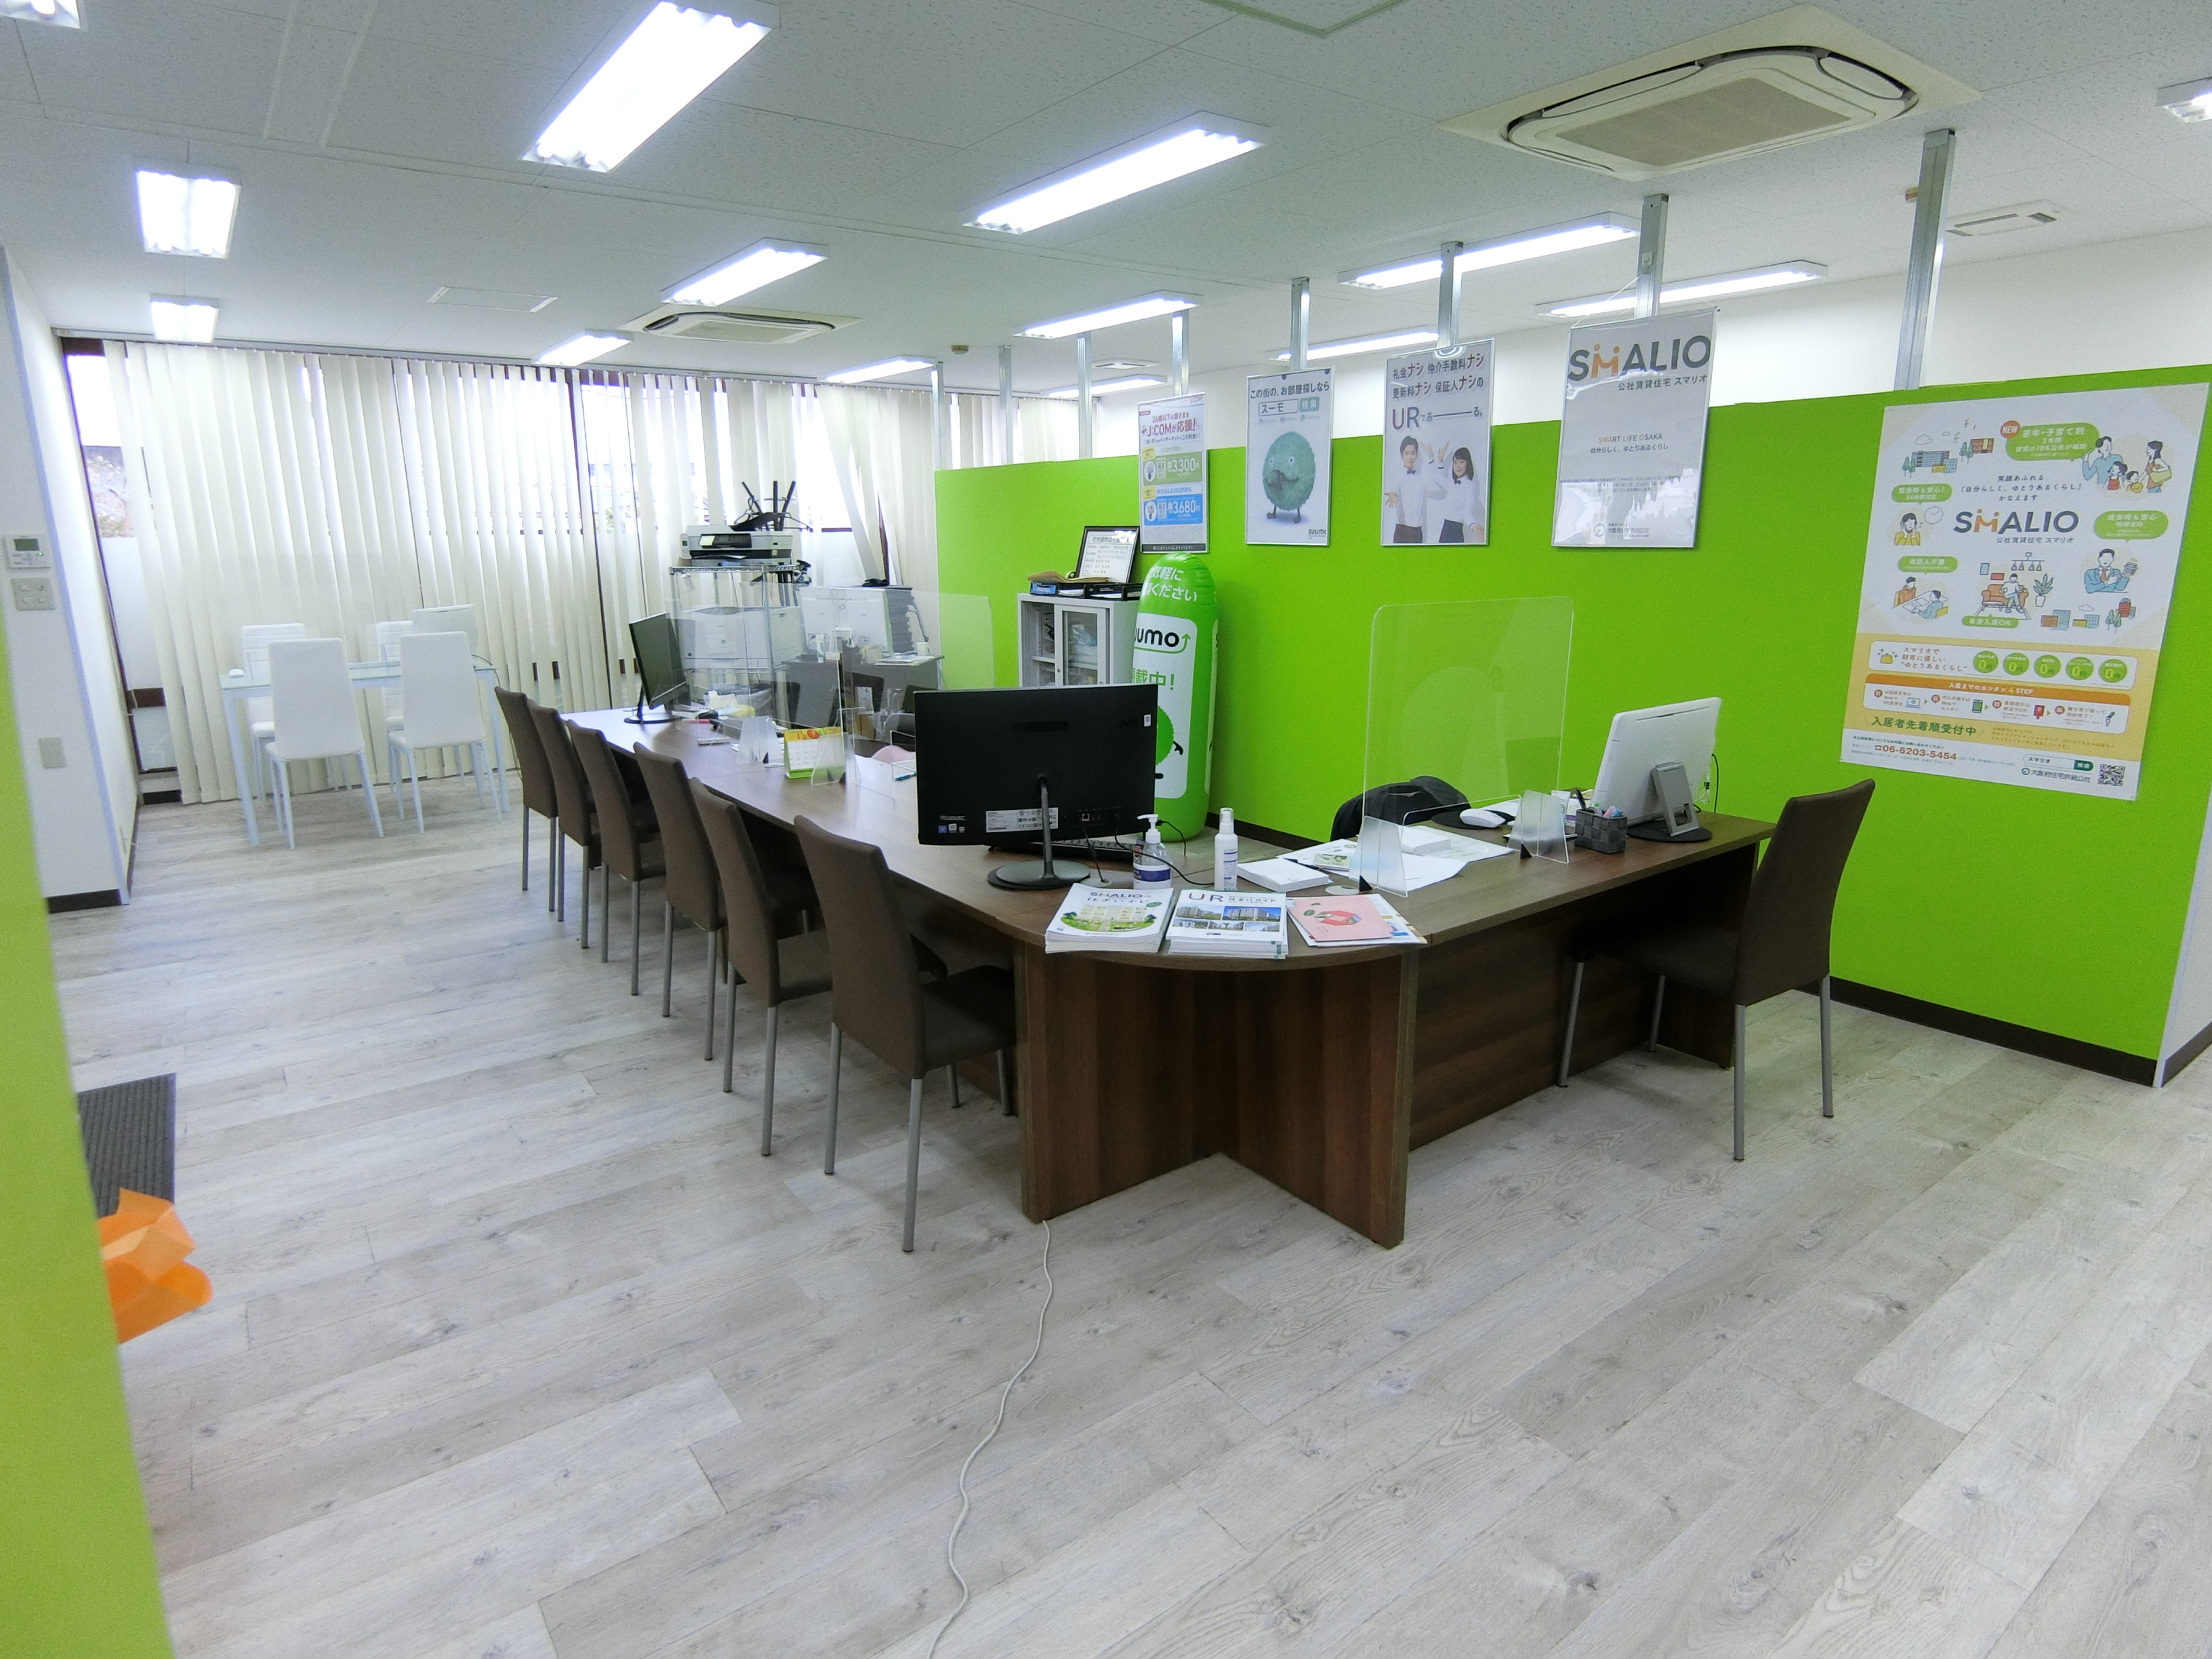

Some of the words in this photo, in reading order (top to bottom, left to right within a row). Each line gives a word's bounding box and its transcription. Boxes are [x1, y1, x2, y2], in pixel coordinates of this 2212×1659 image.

[1393, 363, 1424, 380] 礼金ナシ
[1427, 353, 1485, 375] 仲介手数料ナシ
[1567, 335, 1711, 382] SMALIO
[1250, 382, 1330, 398] この街の、お部屋探しなら
[1393, 381, 1431, 399] 更新料ナシ
[1435, 375, 1483, 393] 保証人ナシの
[1618, 378, 1671, 392] 公社賃貸住宅
[1674, 374, 1707, 386] スマリオ
[1261, 403, 1284, 413] スーモ
[2002, 426, 2018, 434] NEW
[1598, 436, 1620, 444] SMART
[1639, 433, 1662, 441] OSAKA
[1953, 509, 2079, 535] SMALIO
[2015, 687, 2034, 695] STEP
[1871, 716, 1977, 736] 入居者先着順受付中
[1883, 745, 1957, 760] 06-6203-5454
[1188, 893, 1223, 902] UR
